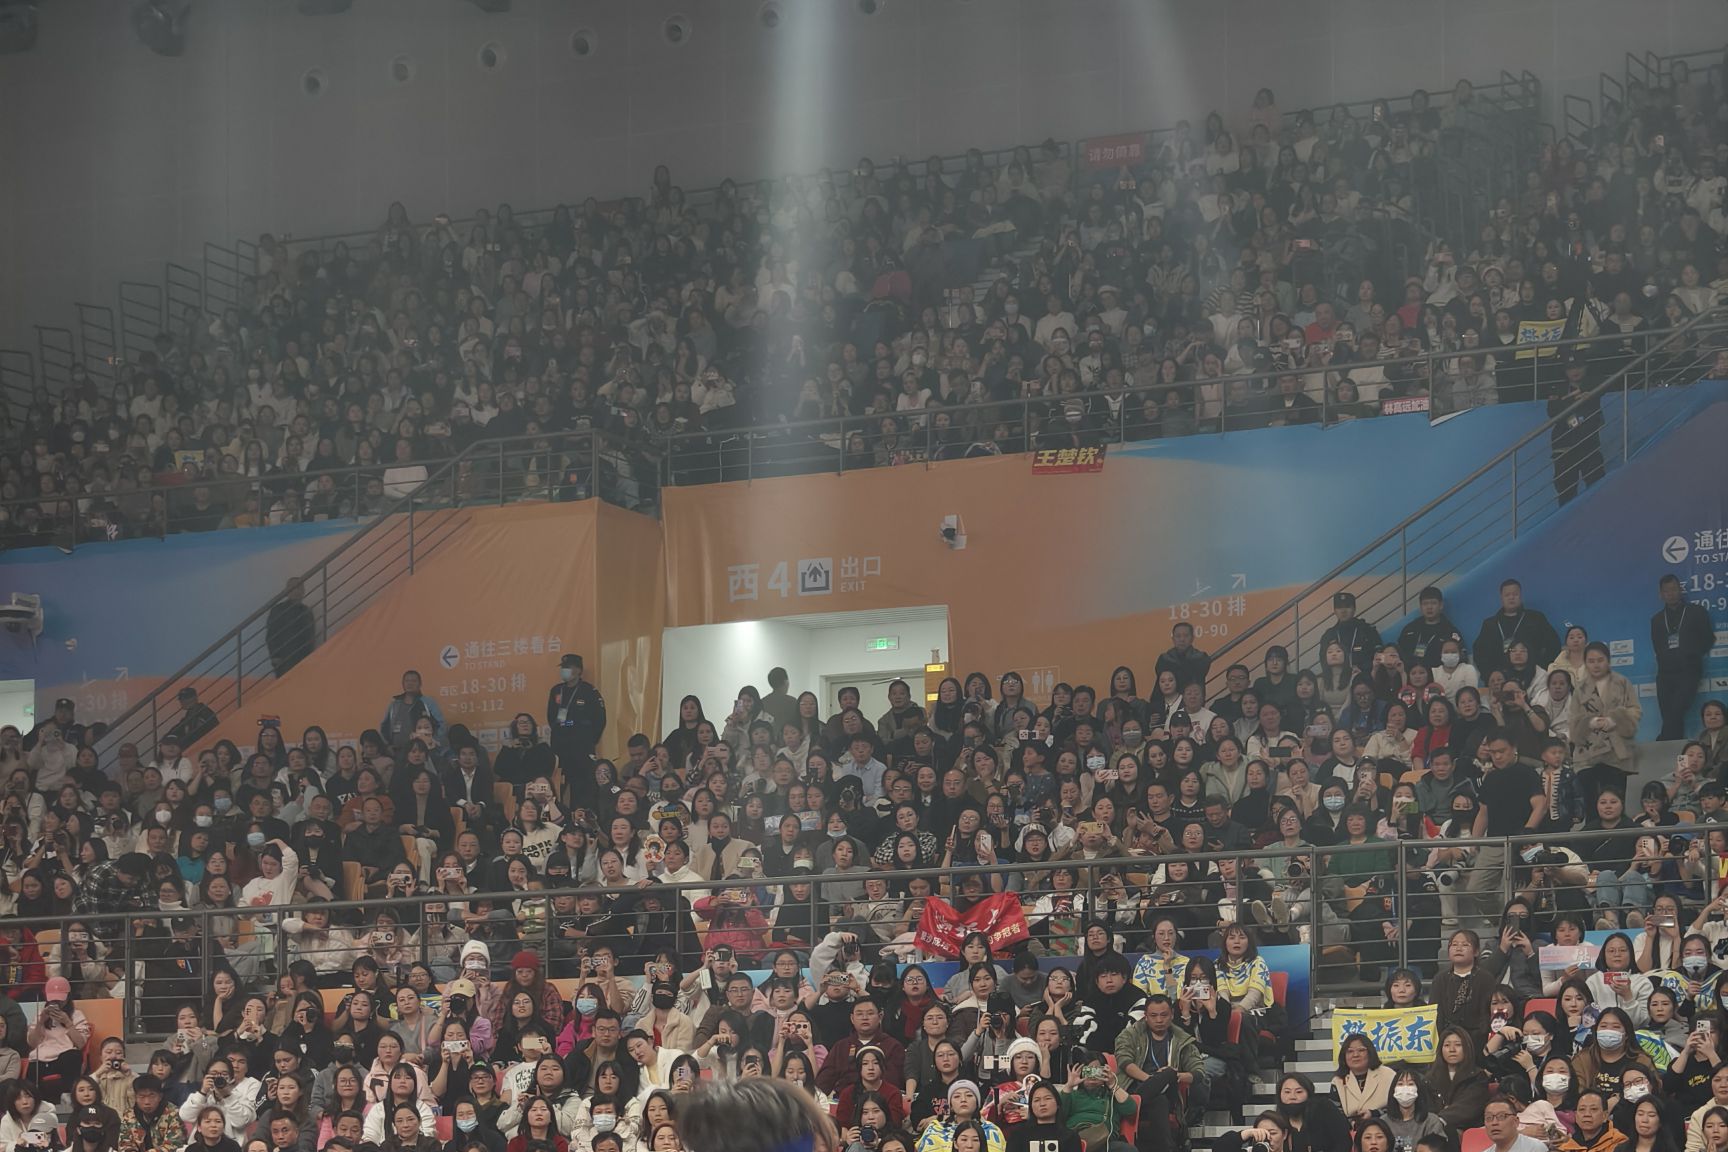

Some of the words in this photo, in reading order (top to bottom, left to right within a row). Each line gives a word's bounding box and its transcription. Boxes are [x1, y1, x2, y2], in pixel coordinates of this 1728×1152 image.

[1033, 446, 1099, 467] 王楚钦
[840, 555, 881, 579] 出口
[727, 562, 761, 603] 西
[767, 560, 791, 598] 4
[840, 580, 867, 593] EXIT
[1168, 599, 1222, 621] 18-30
[464, 634, 562, 659] 通往三楼看台
[460, 676, 507, 696] 18-30
